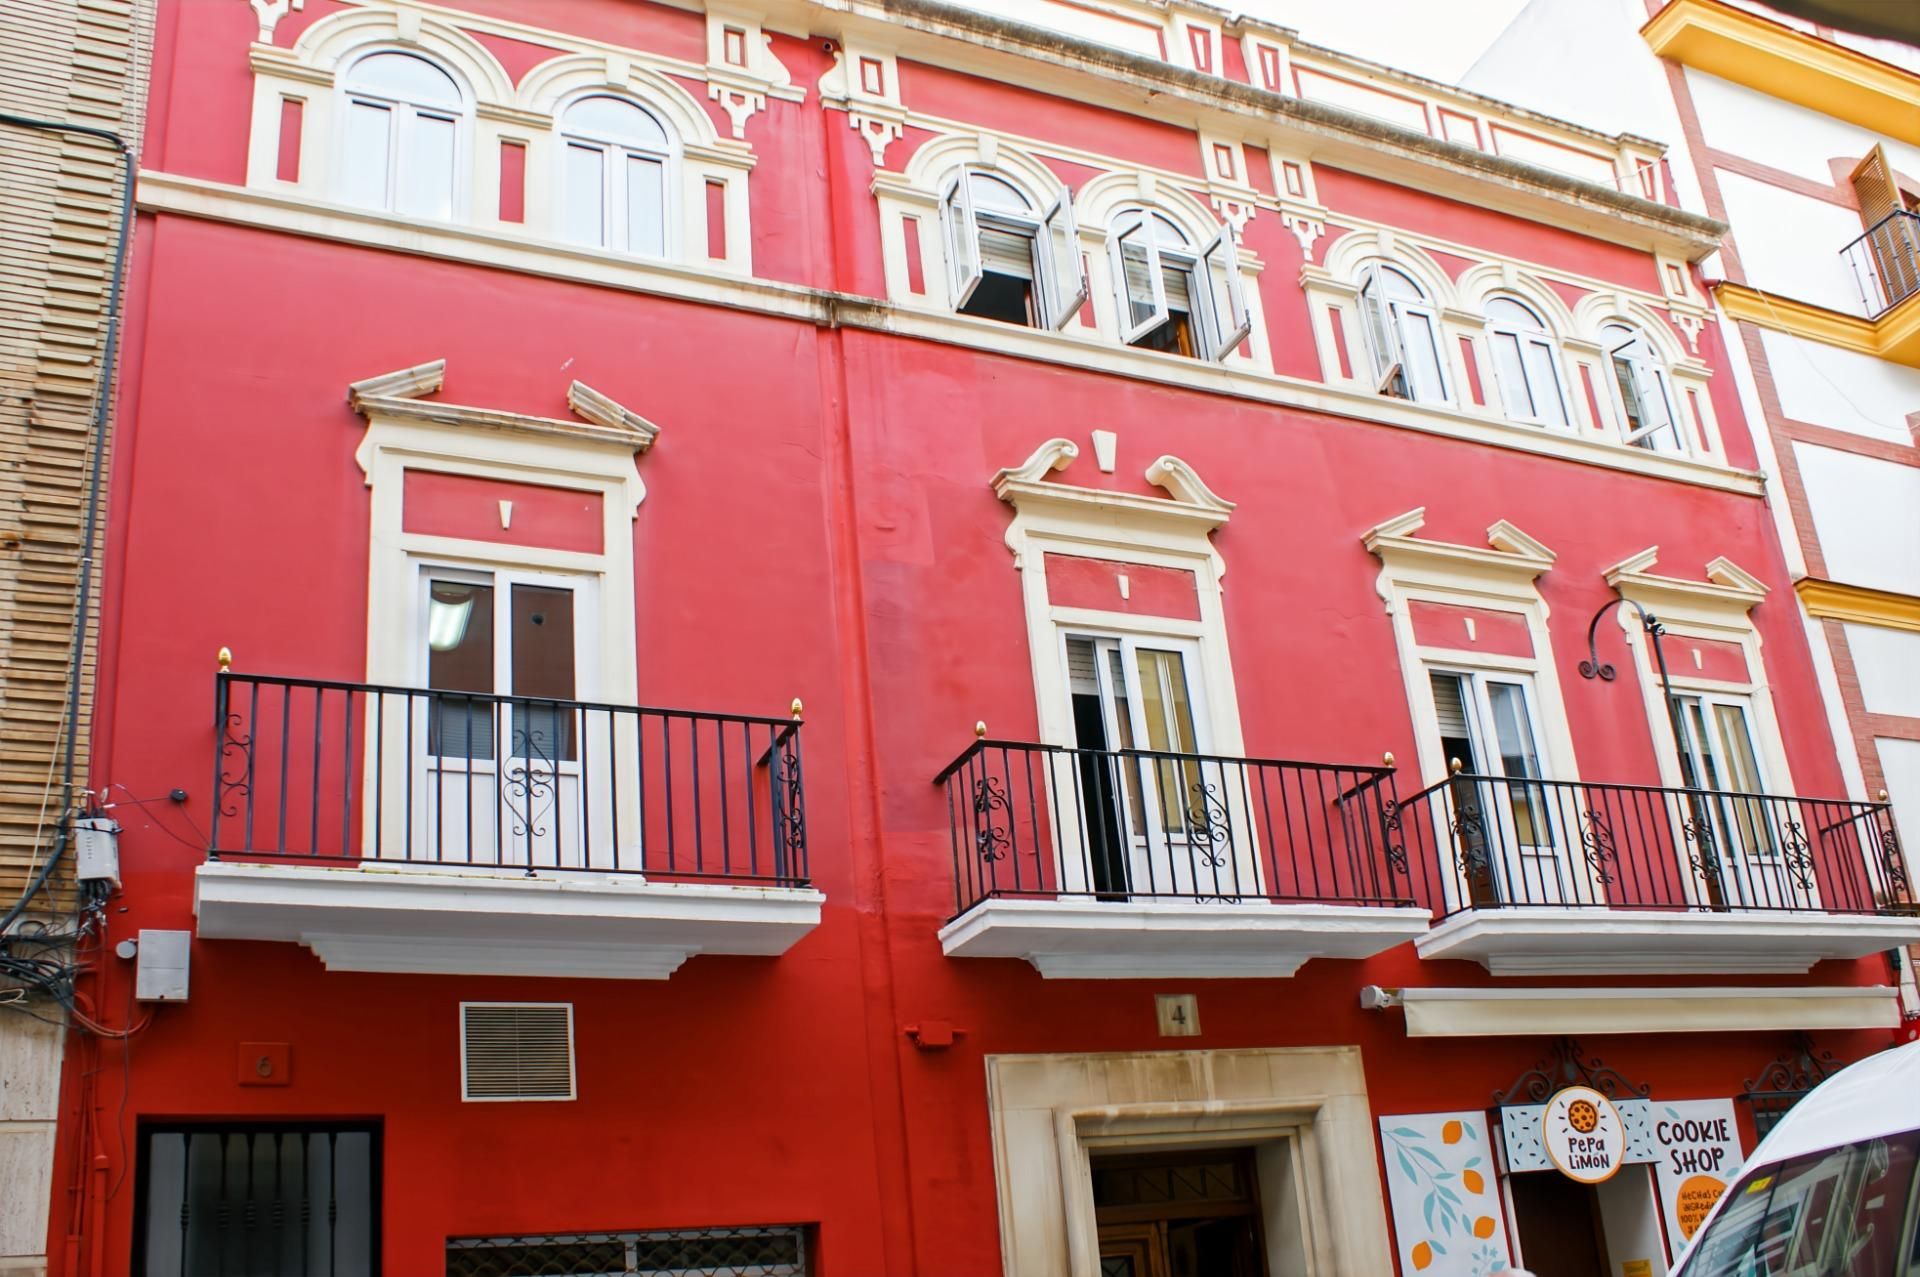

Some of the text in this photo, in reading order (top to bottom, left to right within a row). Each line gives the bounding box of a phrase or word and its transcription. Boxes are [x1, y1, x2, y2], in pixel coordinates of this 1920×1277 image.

[1171, 1005, 1186, 1024] 4
[1657, 1118, 1731, 1145] COOKIE
[1670, 1147, 1724, 1175] SHOP
